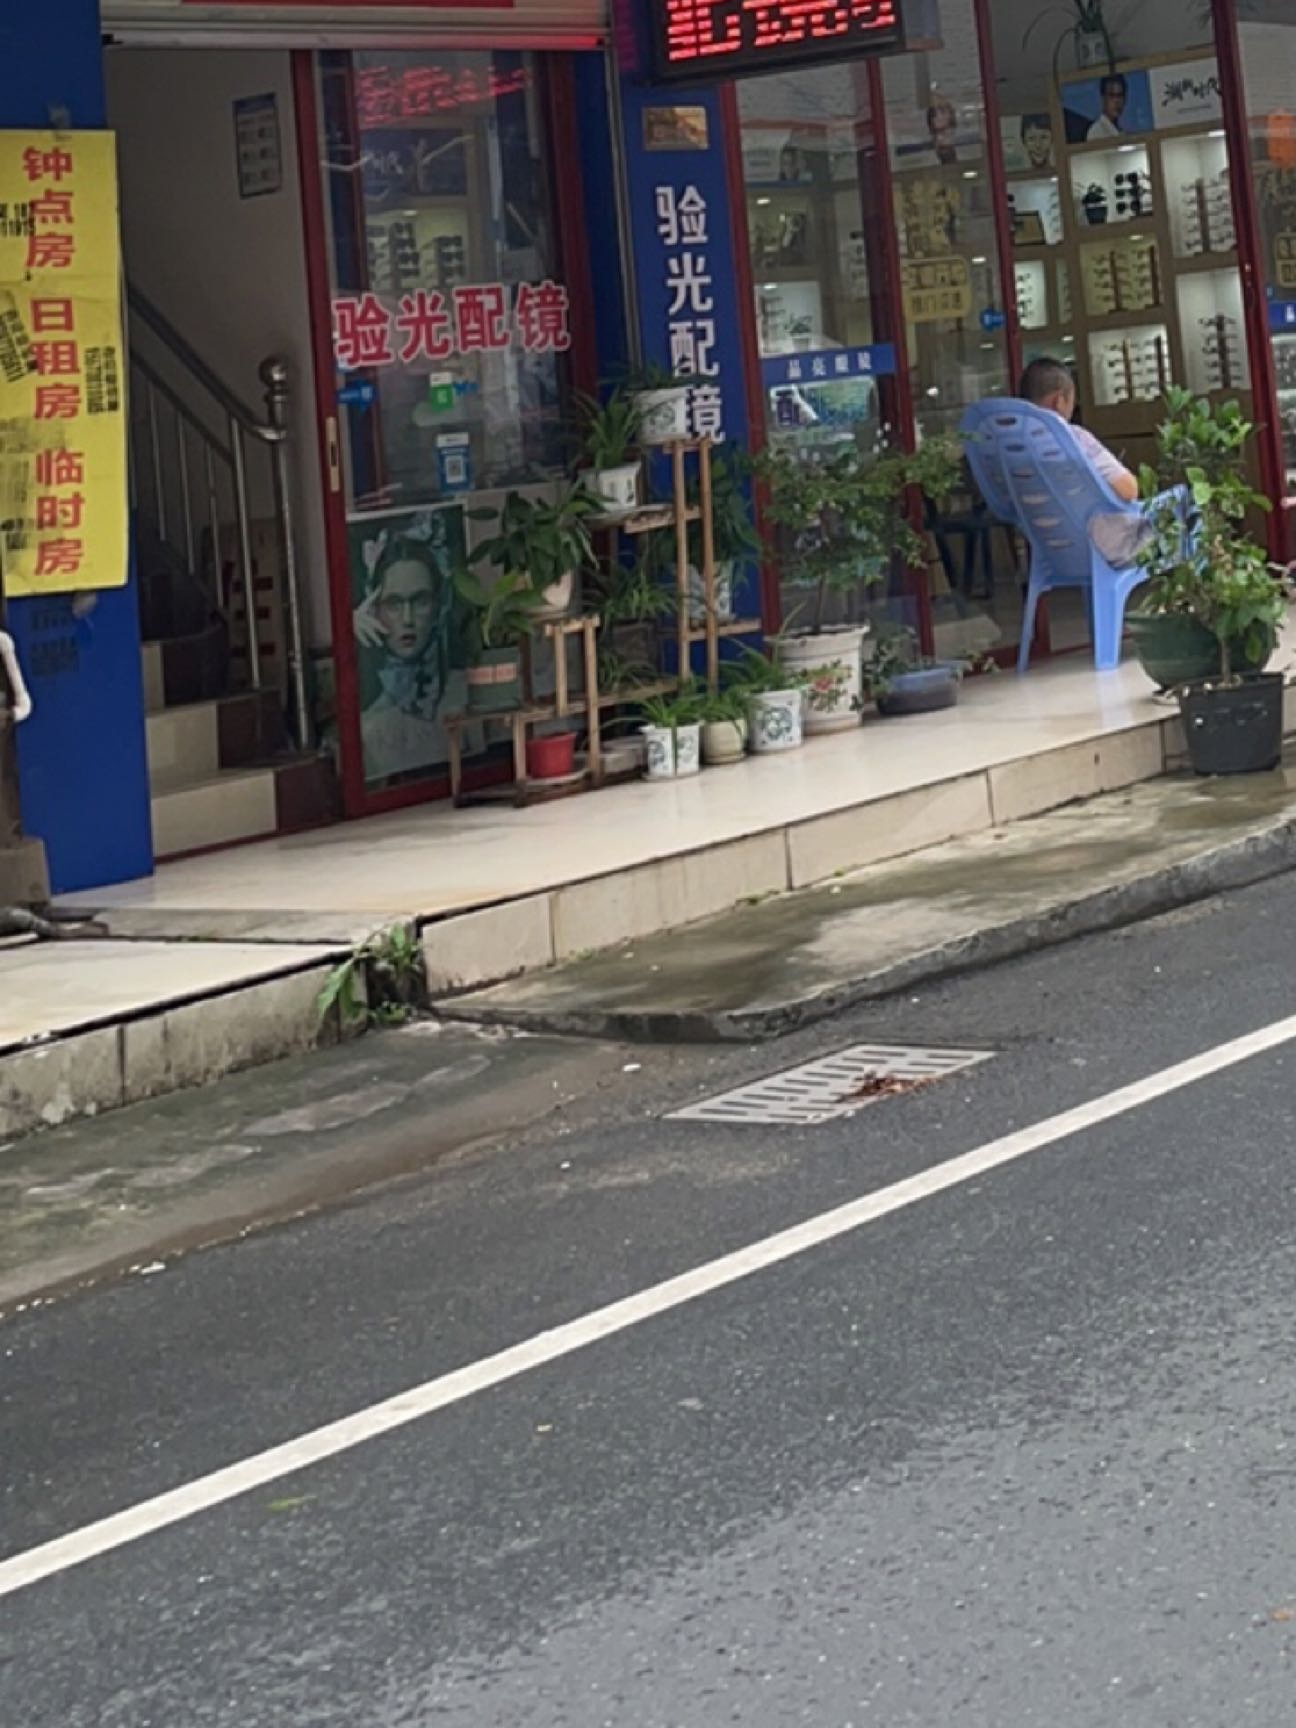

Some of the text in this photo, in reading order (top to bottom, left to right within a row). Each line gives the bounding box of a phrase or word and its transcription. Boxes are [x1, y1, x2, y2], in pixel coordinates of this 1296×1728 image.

[22, 145, 75, 268] 钟点房
[29, 298, 81, 419] 日租房
[331, 279, 571, 368] 验光配镜
[655, 184, 726, 446] 验光配镜
[34, 448, 85, 576] 临时房
